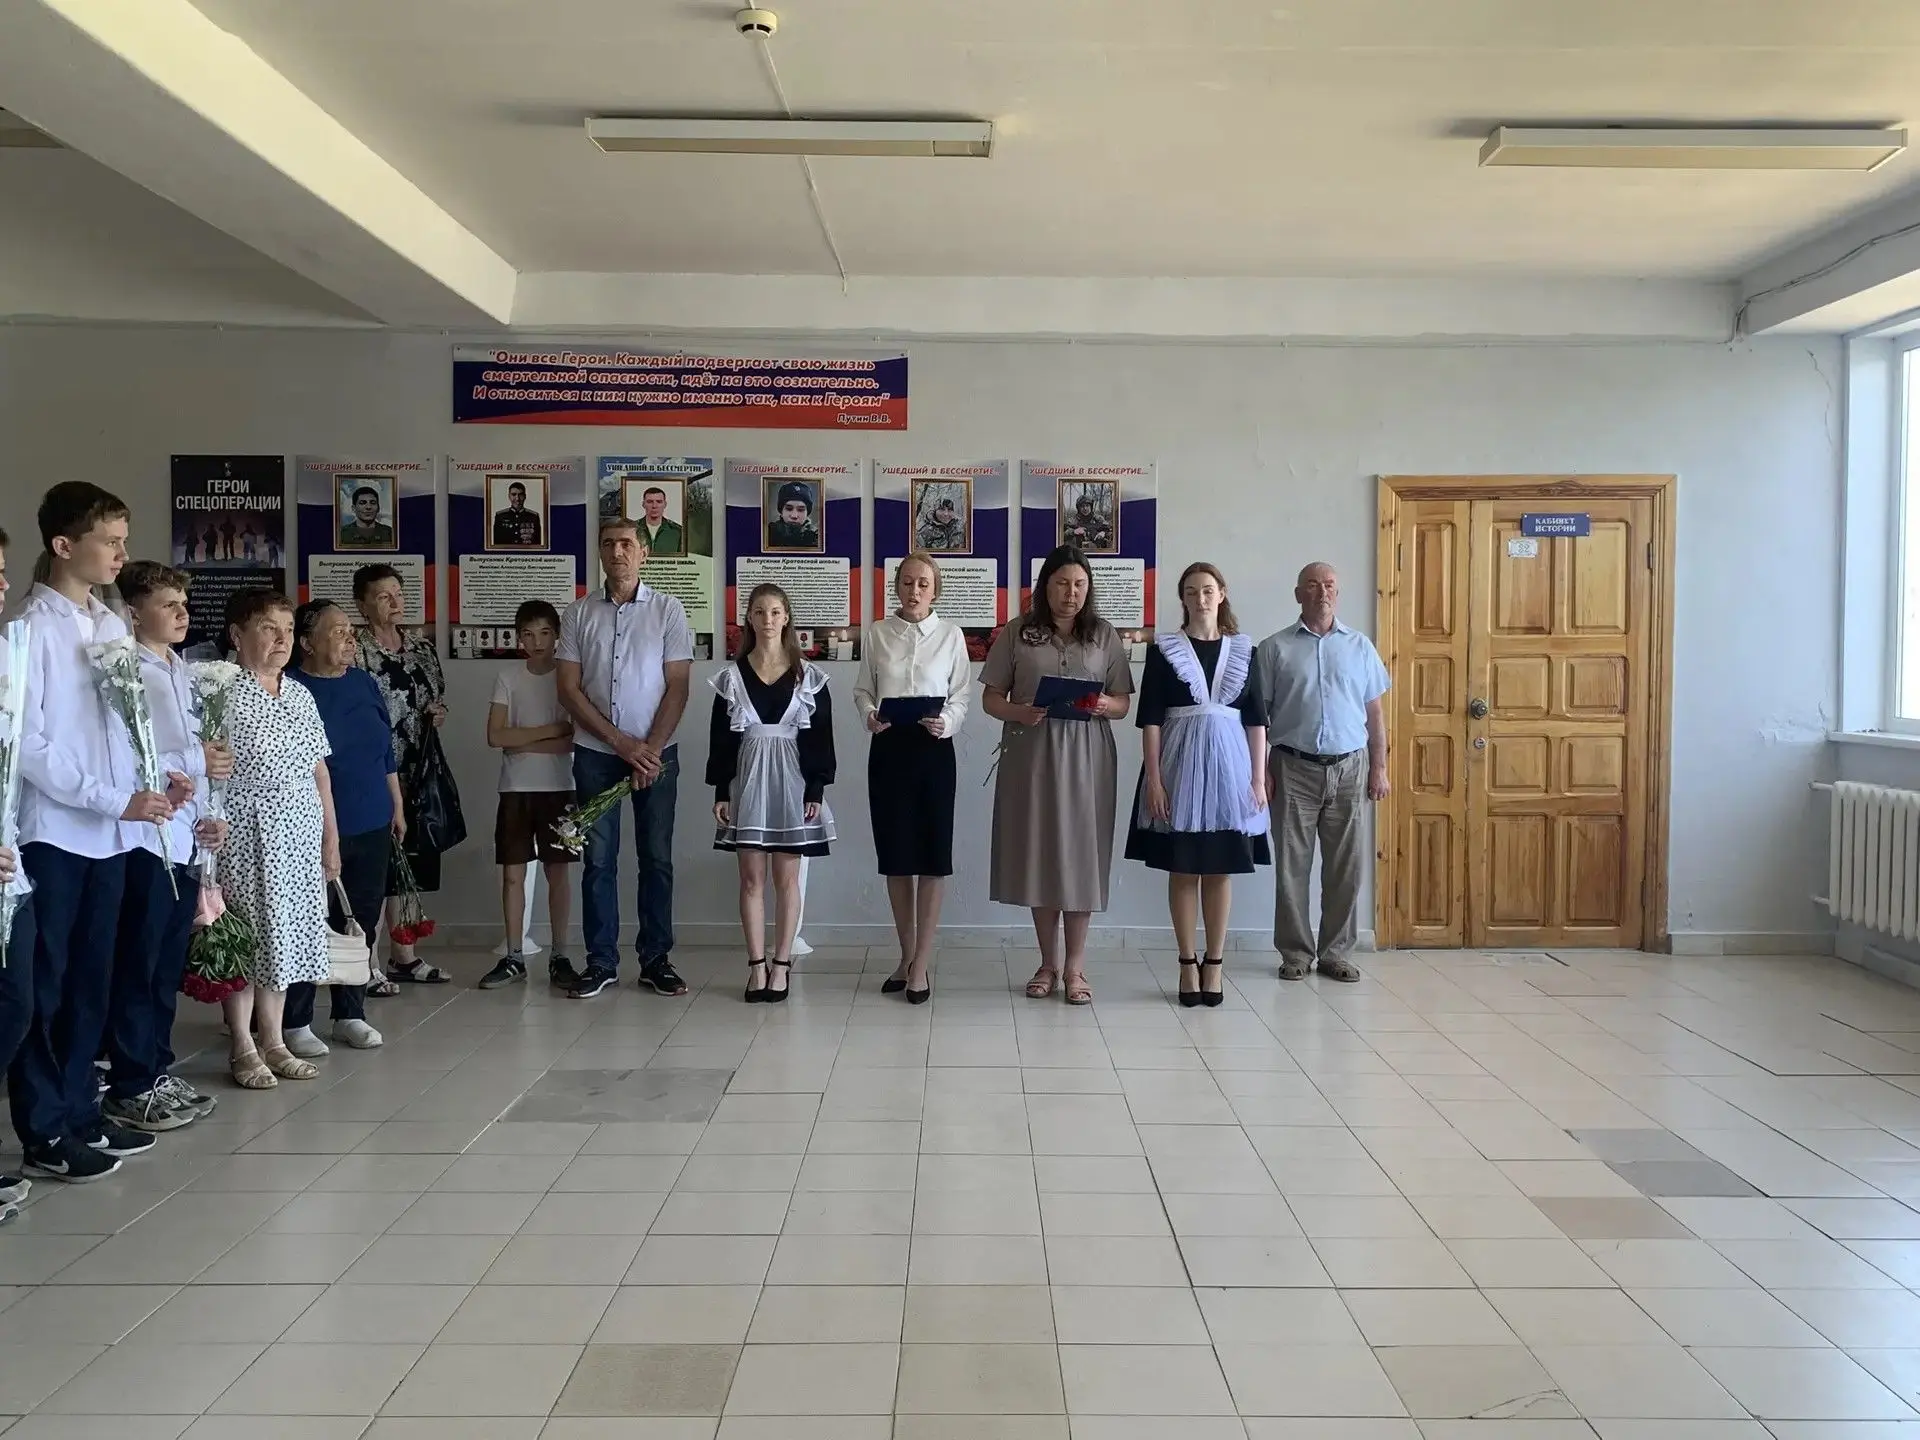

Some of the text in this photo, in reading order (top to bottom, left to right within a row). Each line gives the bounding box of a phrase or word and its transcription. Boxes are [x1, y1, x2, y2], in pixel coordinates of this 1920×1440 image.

[531, 353, 559, 364] все
[560, 351, 612, 368] Герои.
[616, 352, 682, 368] Каждый
[685, 355, 780, 372] подвергает
[782, 358, 823, 371] свою
[823, 359, 876, 371] жизнь
[482, 369, 879, 389] смертельной опасности, идёт на это сознательно.
[473, 385, 891, 409] И относиться к ним нужно именно так, как к Героям"
[837, 413, 892, 425] Путин В.В.
[304, 462, 352, 471] УШЕДШИЙ
[355, 463, 362, 471] В
[455, 462, 504, 471] УШЕДШИЙ
[506, 463, 513, 471] В
[606, 464, 648, 473] УШЕДШИЙ
[732, 465, 780, 473] УШЕДШИЙ
[882, 466, 929, 475] УШЕДШИЙ
[931, 467, 937, 475] В
[1029, 466, 1076, 475] УШЕДШИЙ
[1078, 467, 1085, 475] В
[207, 479, 250, 494] ГЕРОИ
[176, 495, 282, 513] СПЕЦОПЕРАЦИИ
